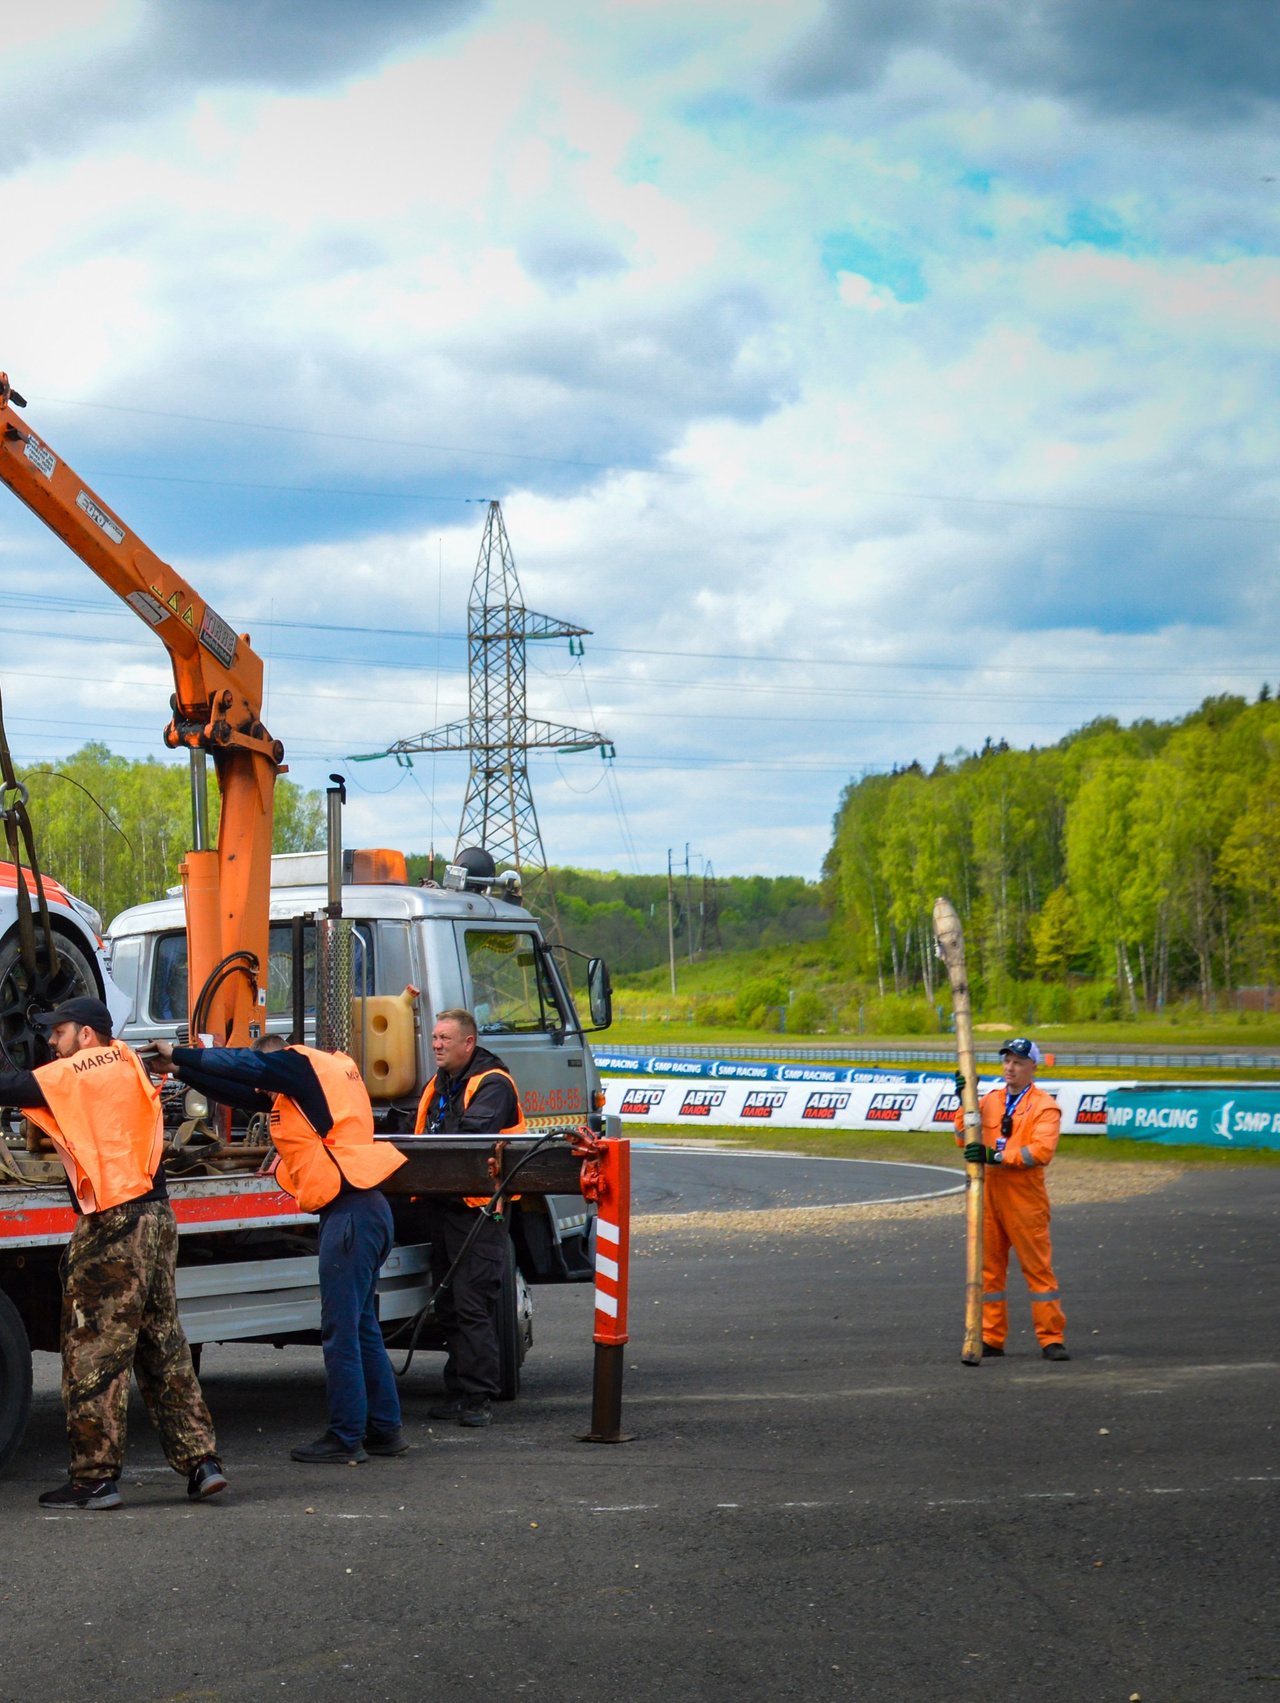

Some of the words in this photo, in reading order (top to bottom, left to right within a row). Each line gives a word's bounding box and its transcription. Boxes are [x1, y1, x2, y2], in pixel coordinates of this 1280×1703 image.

[594, 1058, 610, 1067] SMP
[610, 1059, 639, 1069] RACING
[654, 1061, 672, 1071] SMP
[671, 1063, 702, 1073] RACING
[718, 1065, 737, 1075] SMP
[736, 1066, 768, 1077] RACING
[784, 1069, 803, 1079] SMP
[803, 1070, 836, 1081] RACING
[623, 1090, 663, 1104] АВТО
[683, 1091, 724, 1106] АВТО
[745, 1093, 786, 1107] АВТО
[806, 1093, 850, 1108] АВТО
[870, 1095, 915, 1110] АВТО
[621, 1104, 649, 1113] ПЛЮС
[680, 1105, 709, 1115] ПЛЮС
[742, 1107, 771, 1116] ПЛЮС
[803, 1108, 835, 1118] ПЛЮС
[867, 1110, 900, 1120] ПЛЮС
[1106, 1107, 1133, 1126] MP
[1135, 1108, 1198, 1129] RACING
[1233, 1111, 1270, 1132] SMP
